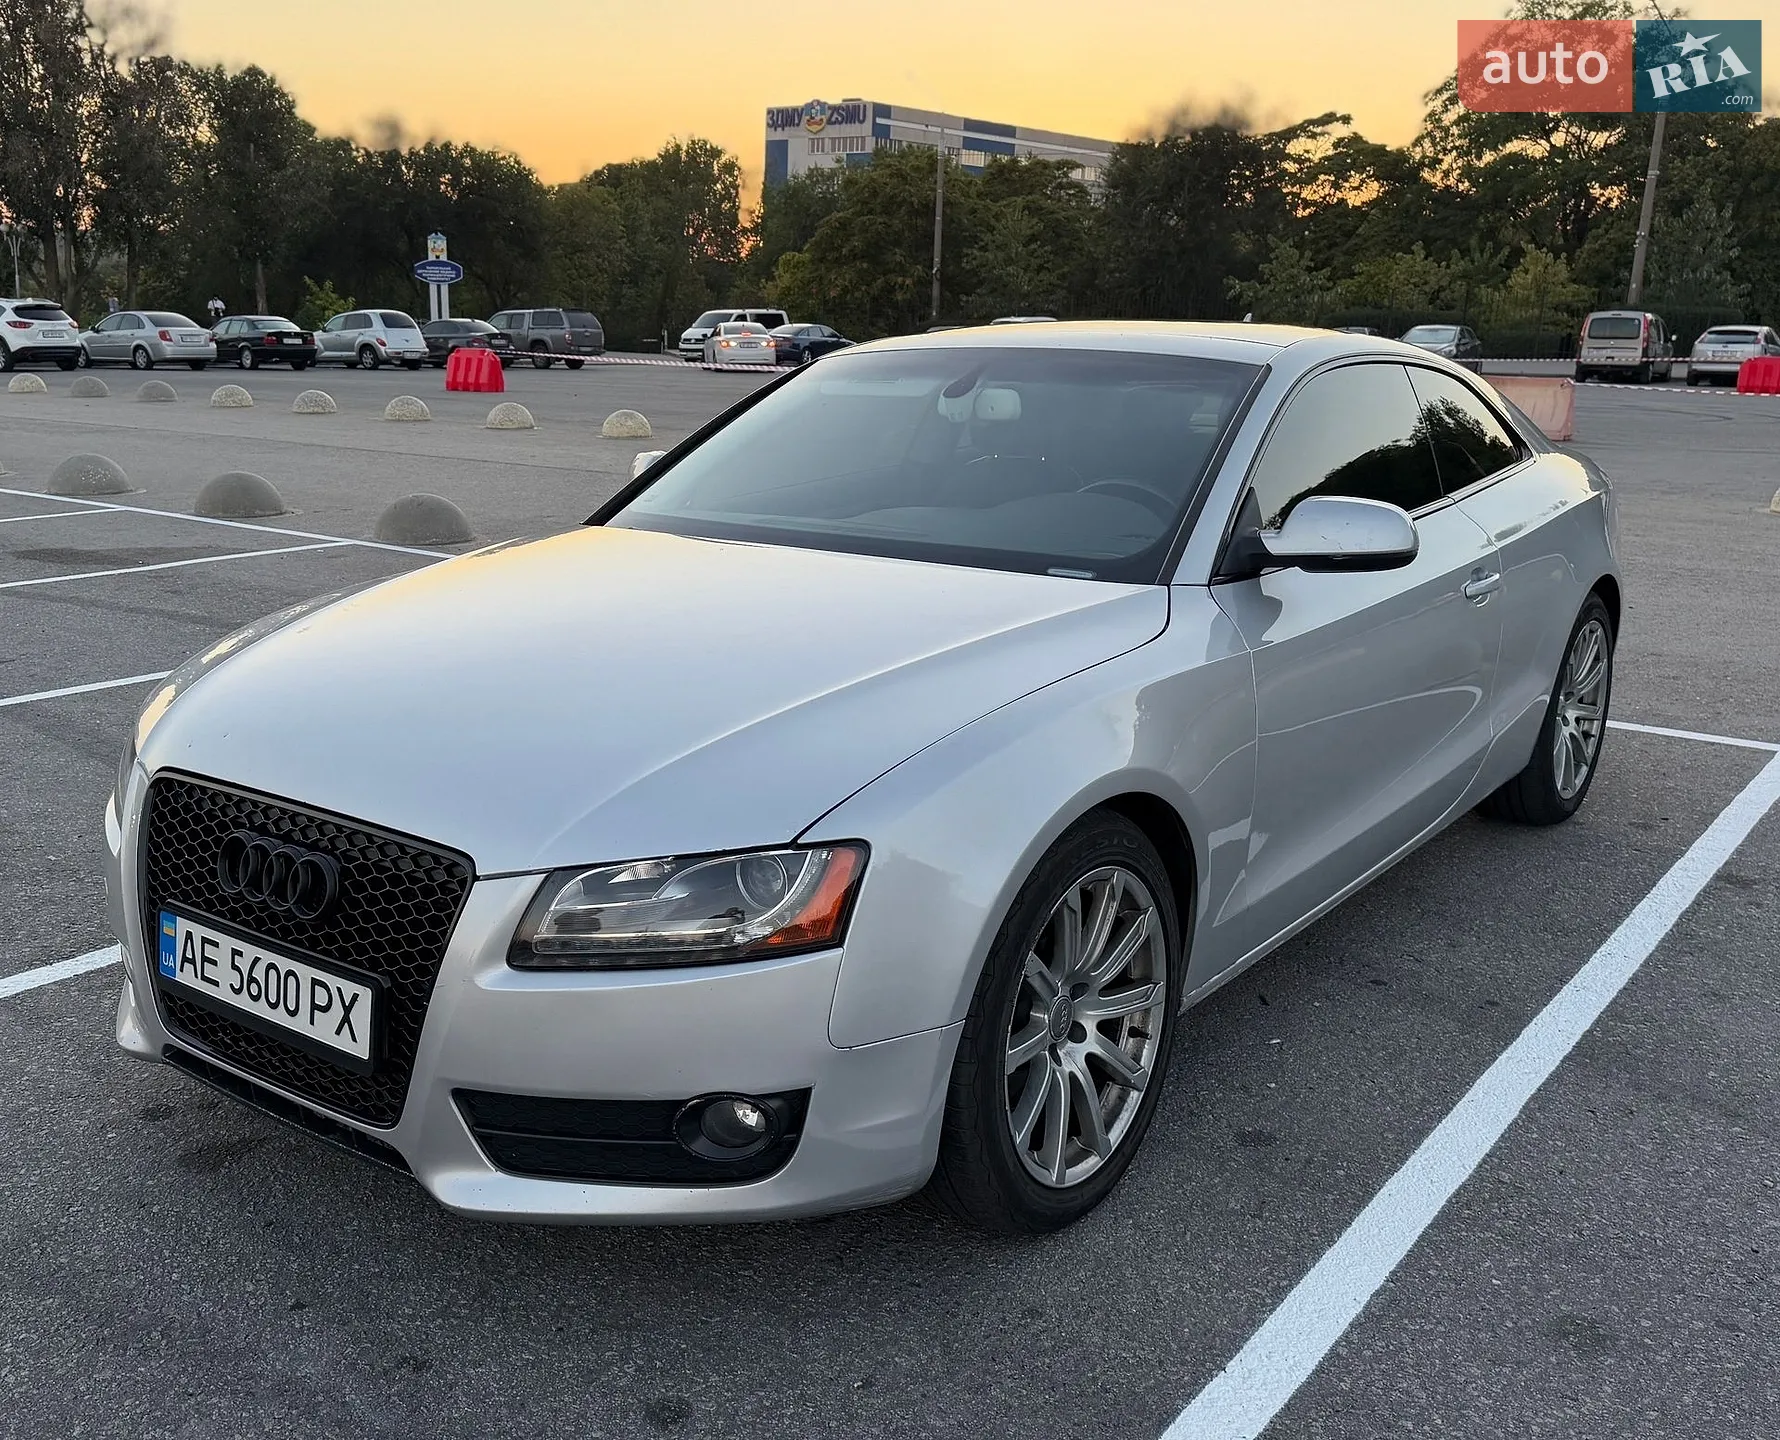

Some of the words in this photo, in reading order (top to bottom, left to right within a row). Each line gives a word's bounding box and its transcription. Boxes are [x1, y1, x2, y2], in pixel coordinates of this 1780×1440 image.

[767, 107, 805, 132] ЗДМУ
[827, 104, 867, 125] ZSMU
[162, 951, 175, 969] UA
[179, 929, 220, 988] AE
[229, 946, 301, 1018] 5600
[309, 976, 360, 1044] PX
